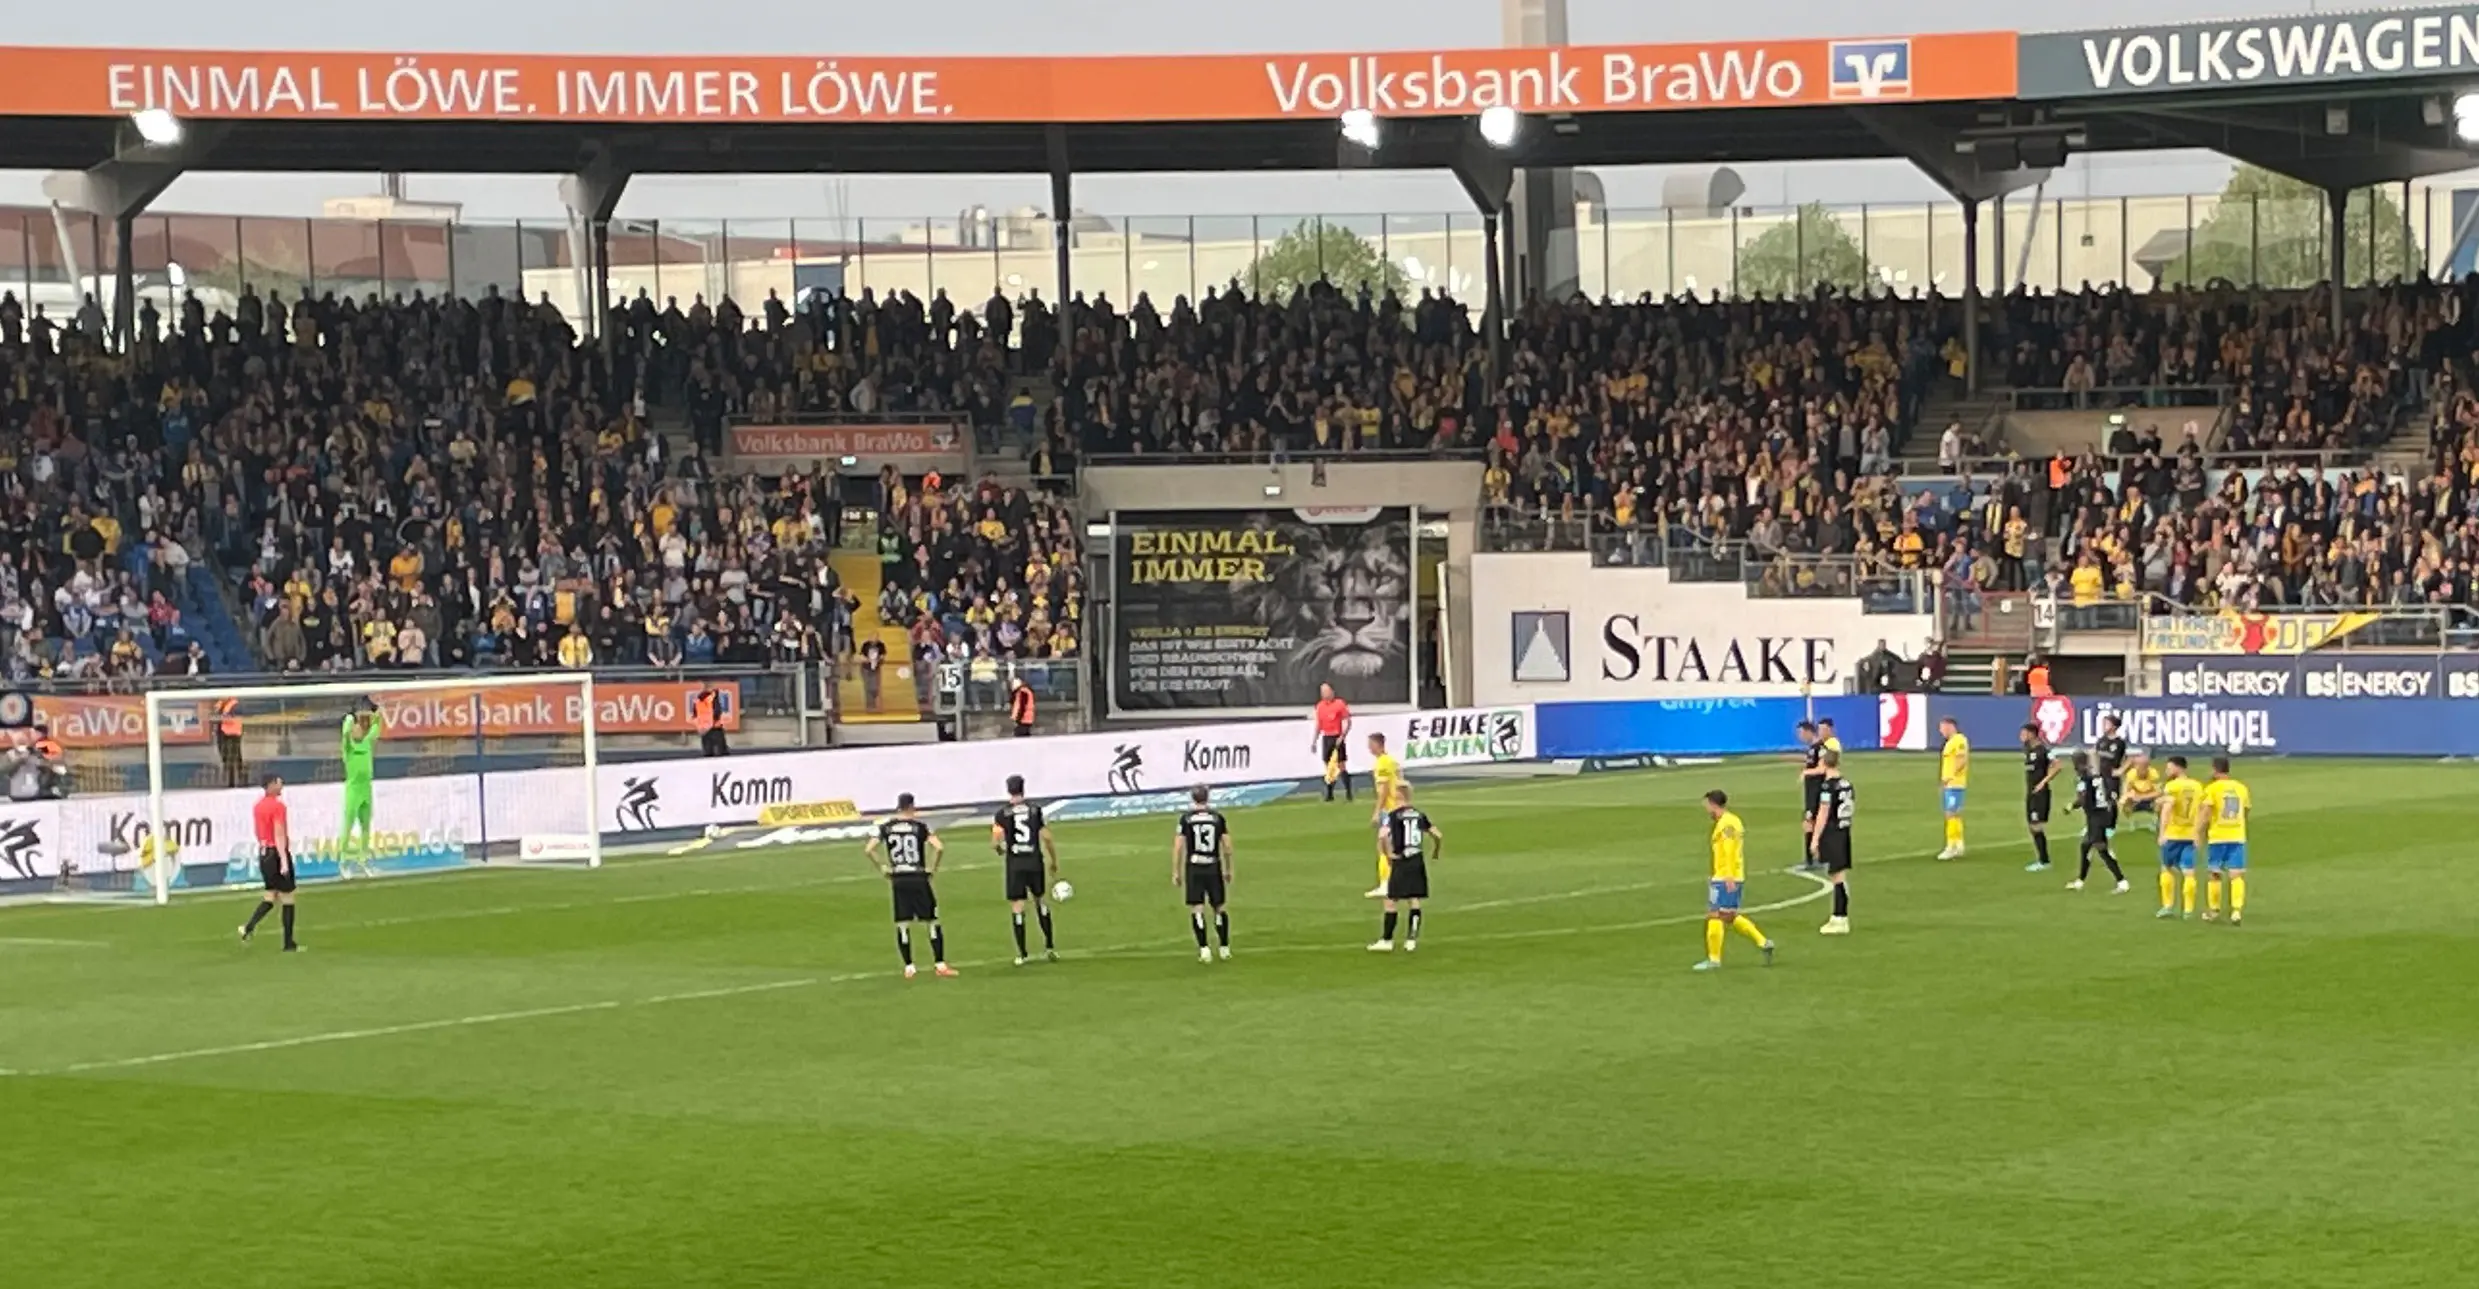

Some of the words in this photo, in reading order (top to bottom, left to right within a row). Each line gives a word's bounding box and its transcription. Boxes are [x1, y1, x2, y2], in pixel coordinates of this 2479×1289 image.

[2082, 15, 2479, 88] VOLKSWAGEN
[107, 64, 339, 111] EINMAL
[358, 57, 537, 114] LÖWE.
[556, 70, 760, 115] IMMER
[781, 61, 953, 115] LÖWE.
[1266, 52, 1580, 111] Volksbank
[1602, 50, 1803, 101] BraWo
[736, 431, 847, 453] Volksbank
[854, 432, 924, 450] BraWo
[1131, 530, 1296, 556] EINMAL,
[1131, 558, 1275, 584] IMMER.
[2034, 604, 2055, 622] 14
[937, 667, 961, 689] 15
[1407, 713, 1489, 740] E-BIKE
[1183, 739, 1250, 772] Komm
[1404, 734, 1486, 760] KASTEN
[711, 771, 793, 808] Komm
[1013, 813, 1030, 842] 5
[1194, 823, 1216, 853] 13
[887, 834, 920, 863] 28
